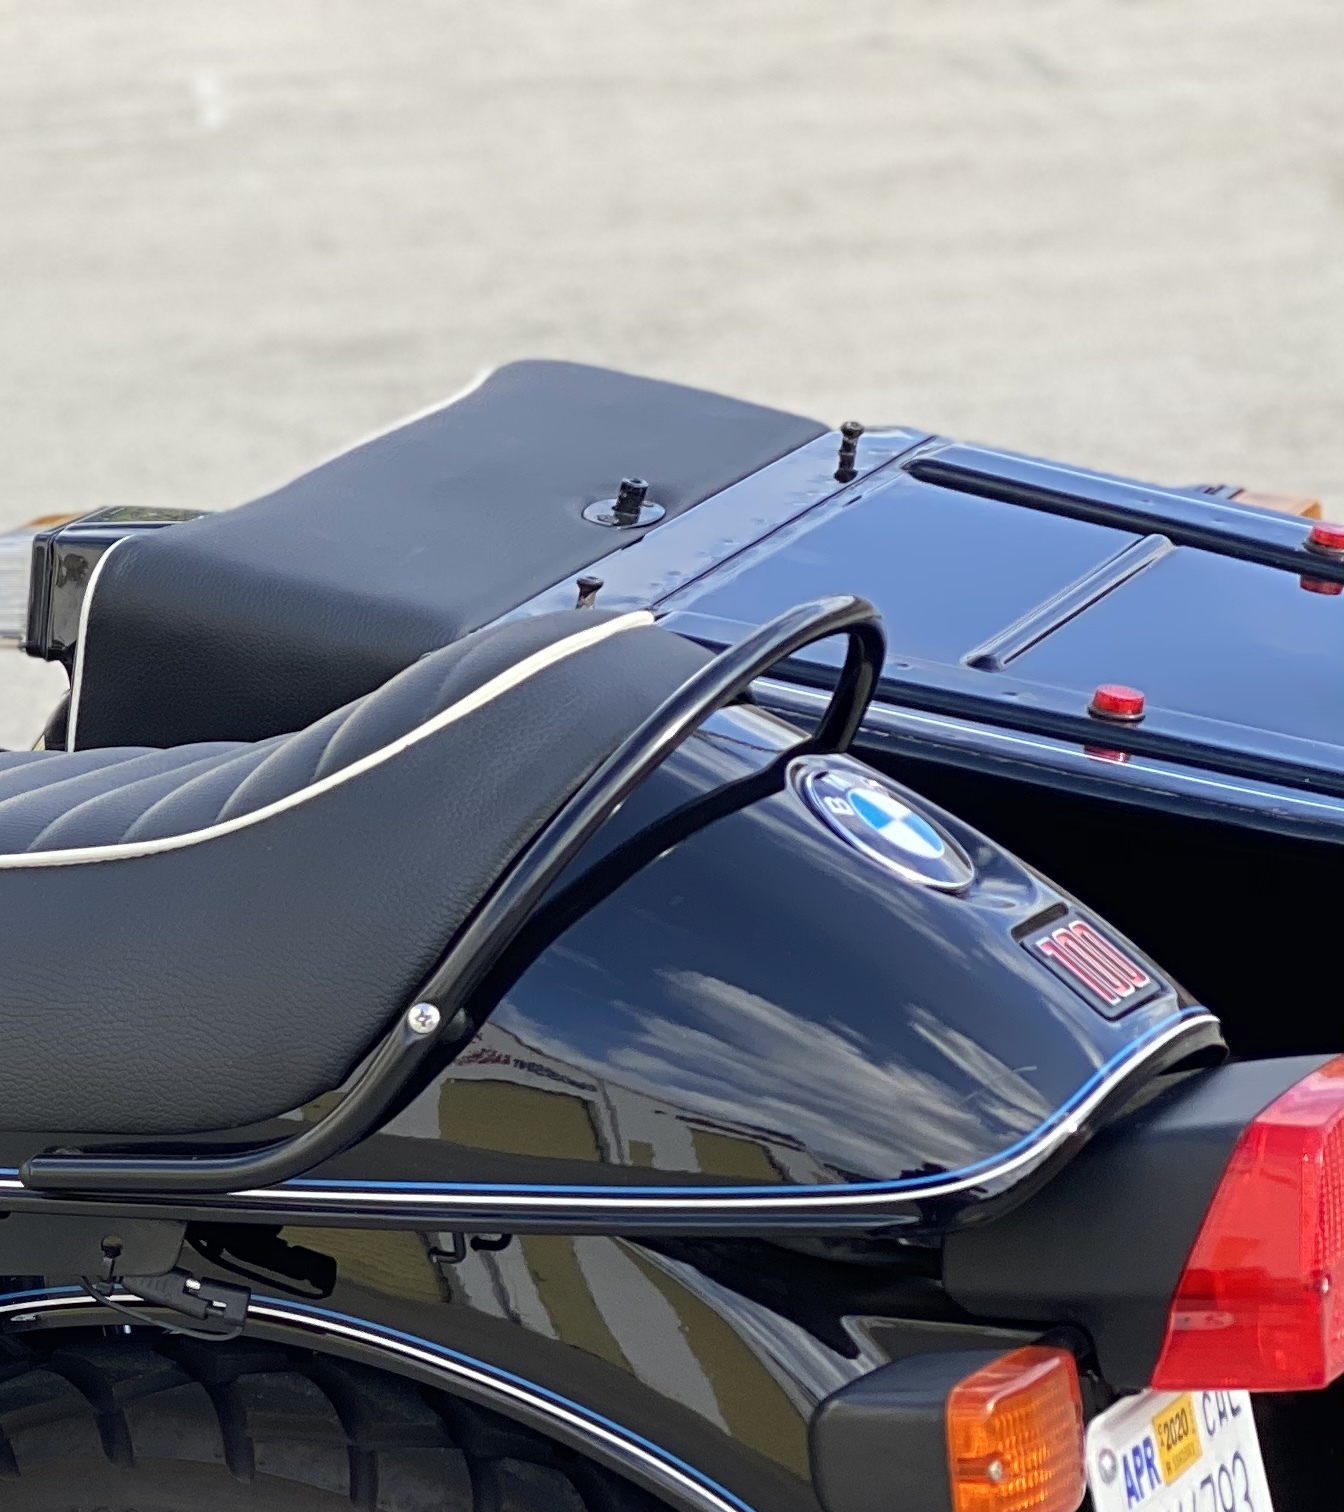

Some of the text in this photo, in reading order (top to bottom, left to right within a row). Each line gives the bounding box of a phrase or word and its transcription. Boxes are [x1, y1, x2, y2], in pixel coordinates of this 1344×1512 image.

[1035, 919, 1151, 1006] 100
[1163, 1406, 1189, 1452] 2020
[1122, 1434, 1162, 1510] APR
